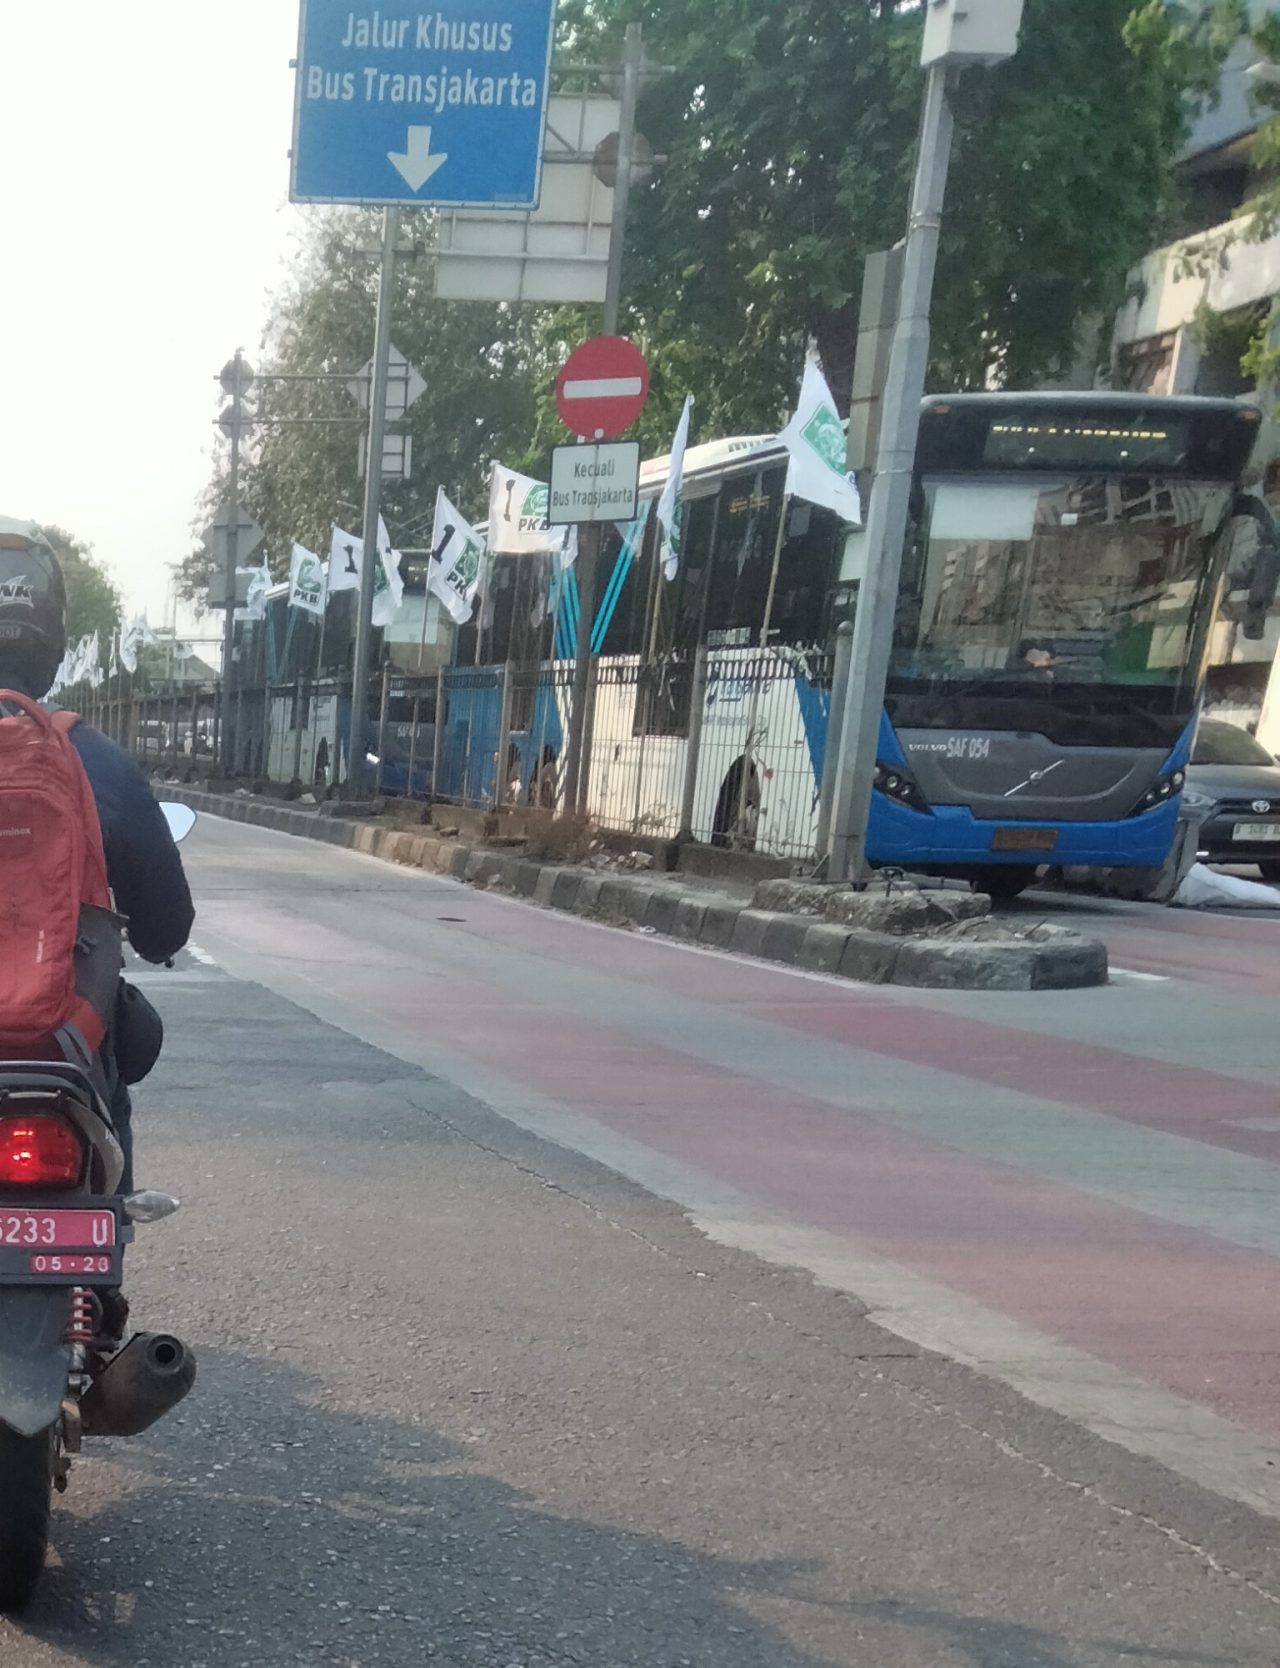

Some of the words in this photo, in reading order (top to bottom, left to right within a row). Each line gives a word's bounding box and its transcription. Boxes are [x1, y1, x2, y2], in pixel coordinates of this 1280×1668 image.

[341, 11, 410, 48] Jalur
[415, 12, 513, 51] Khusus
[306, 65, 355, 101] Bus
[363, 65, 537, 113] Transjakarta
[573, 459, 615, 478] Kecuali
[552, 491, 570, 507] Bus
[572, 488, 633, 509] Transjakarta
[432, 524, 456, 564] 1
[343, 545, 358, 574] 1
[293, 588, 319, 604] PKB
[92, 1218, 108, 1246] U
